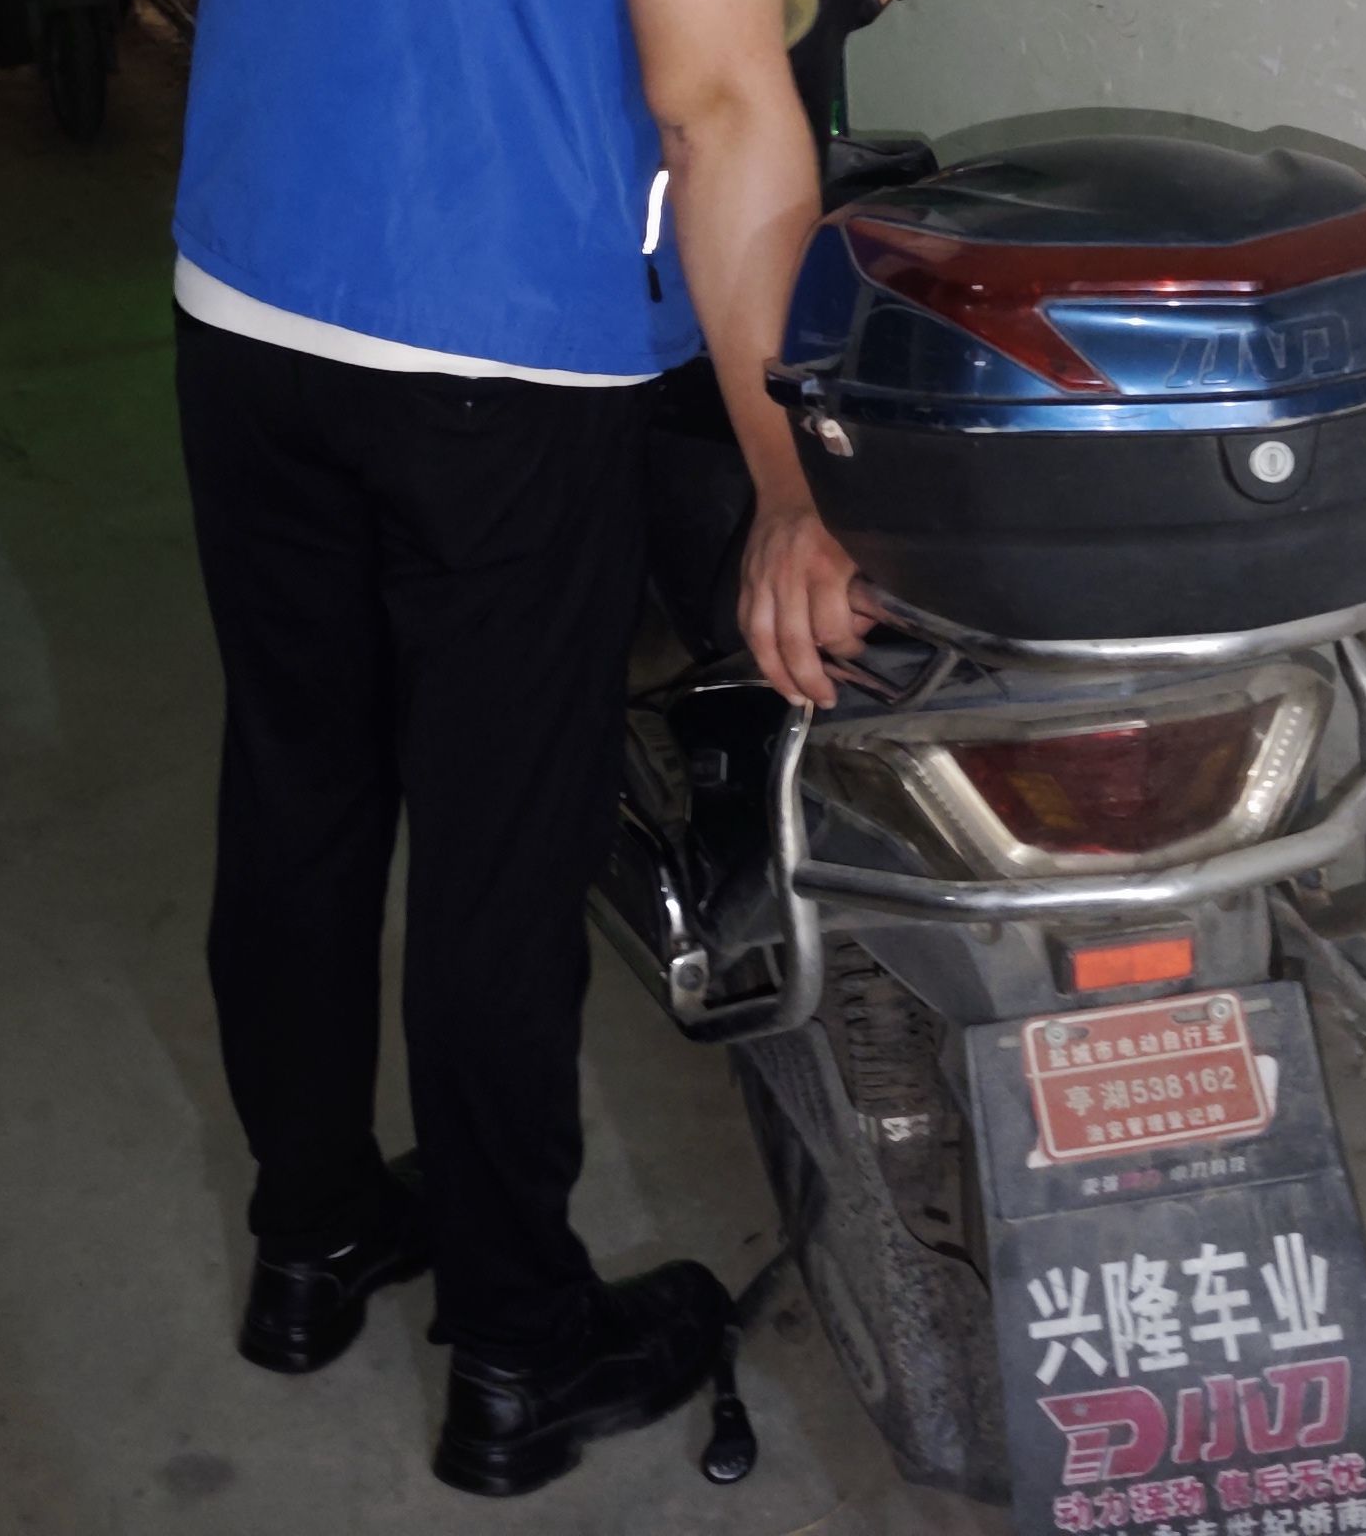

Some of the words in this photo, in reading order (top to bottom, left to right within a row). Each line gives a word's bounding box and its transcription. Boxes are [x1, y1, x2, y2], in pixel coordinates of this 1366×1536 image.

[1048, 1023, 1227, 1068] 盐城市电动自行车
[1063, 1065, 1237, 1117] 亭湖538162
[1027, 1233, 1345, 1386] 兴隆车业
[1053, 1476, 1206, 1533] 动力强劲
